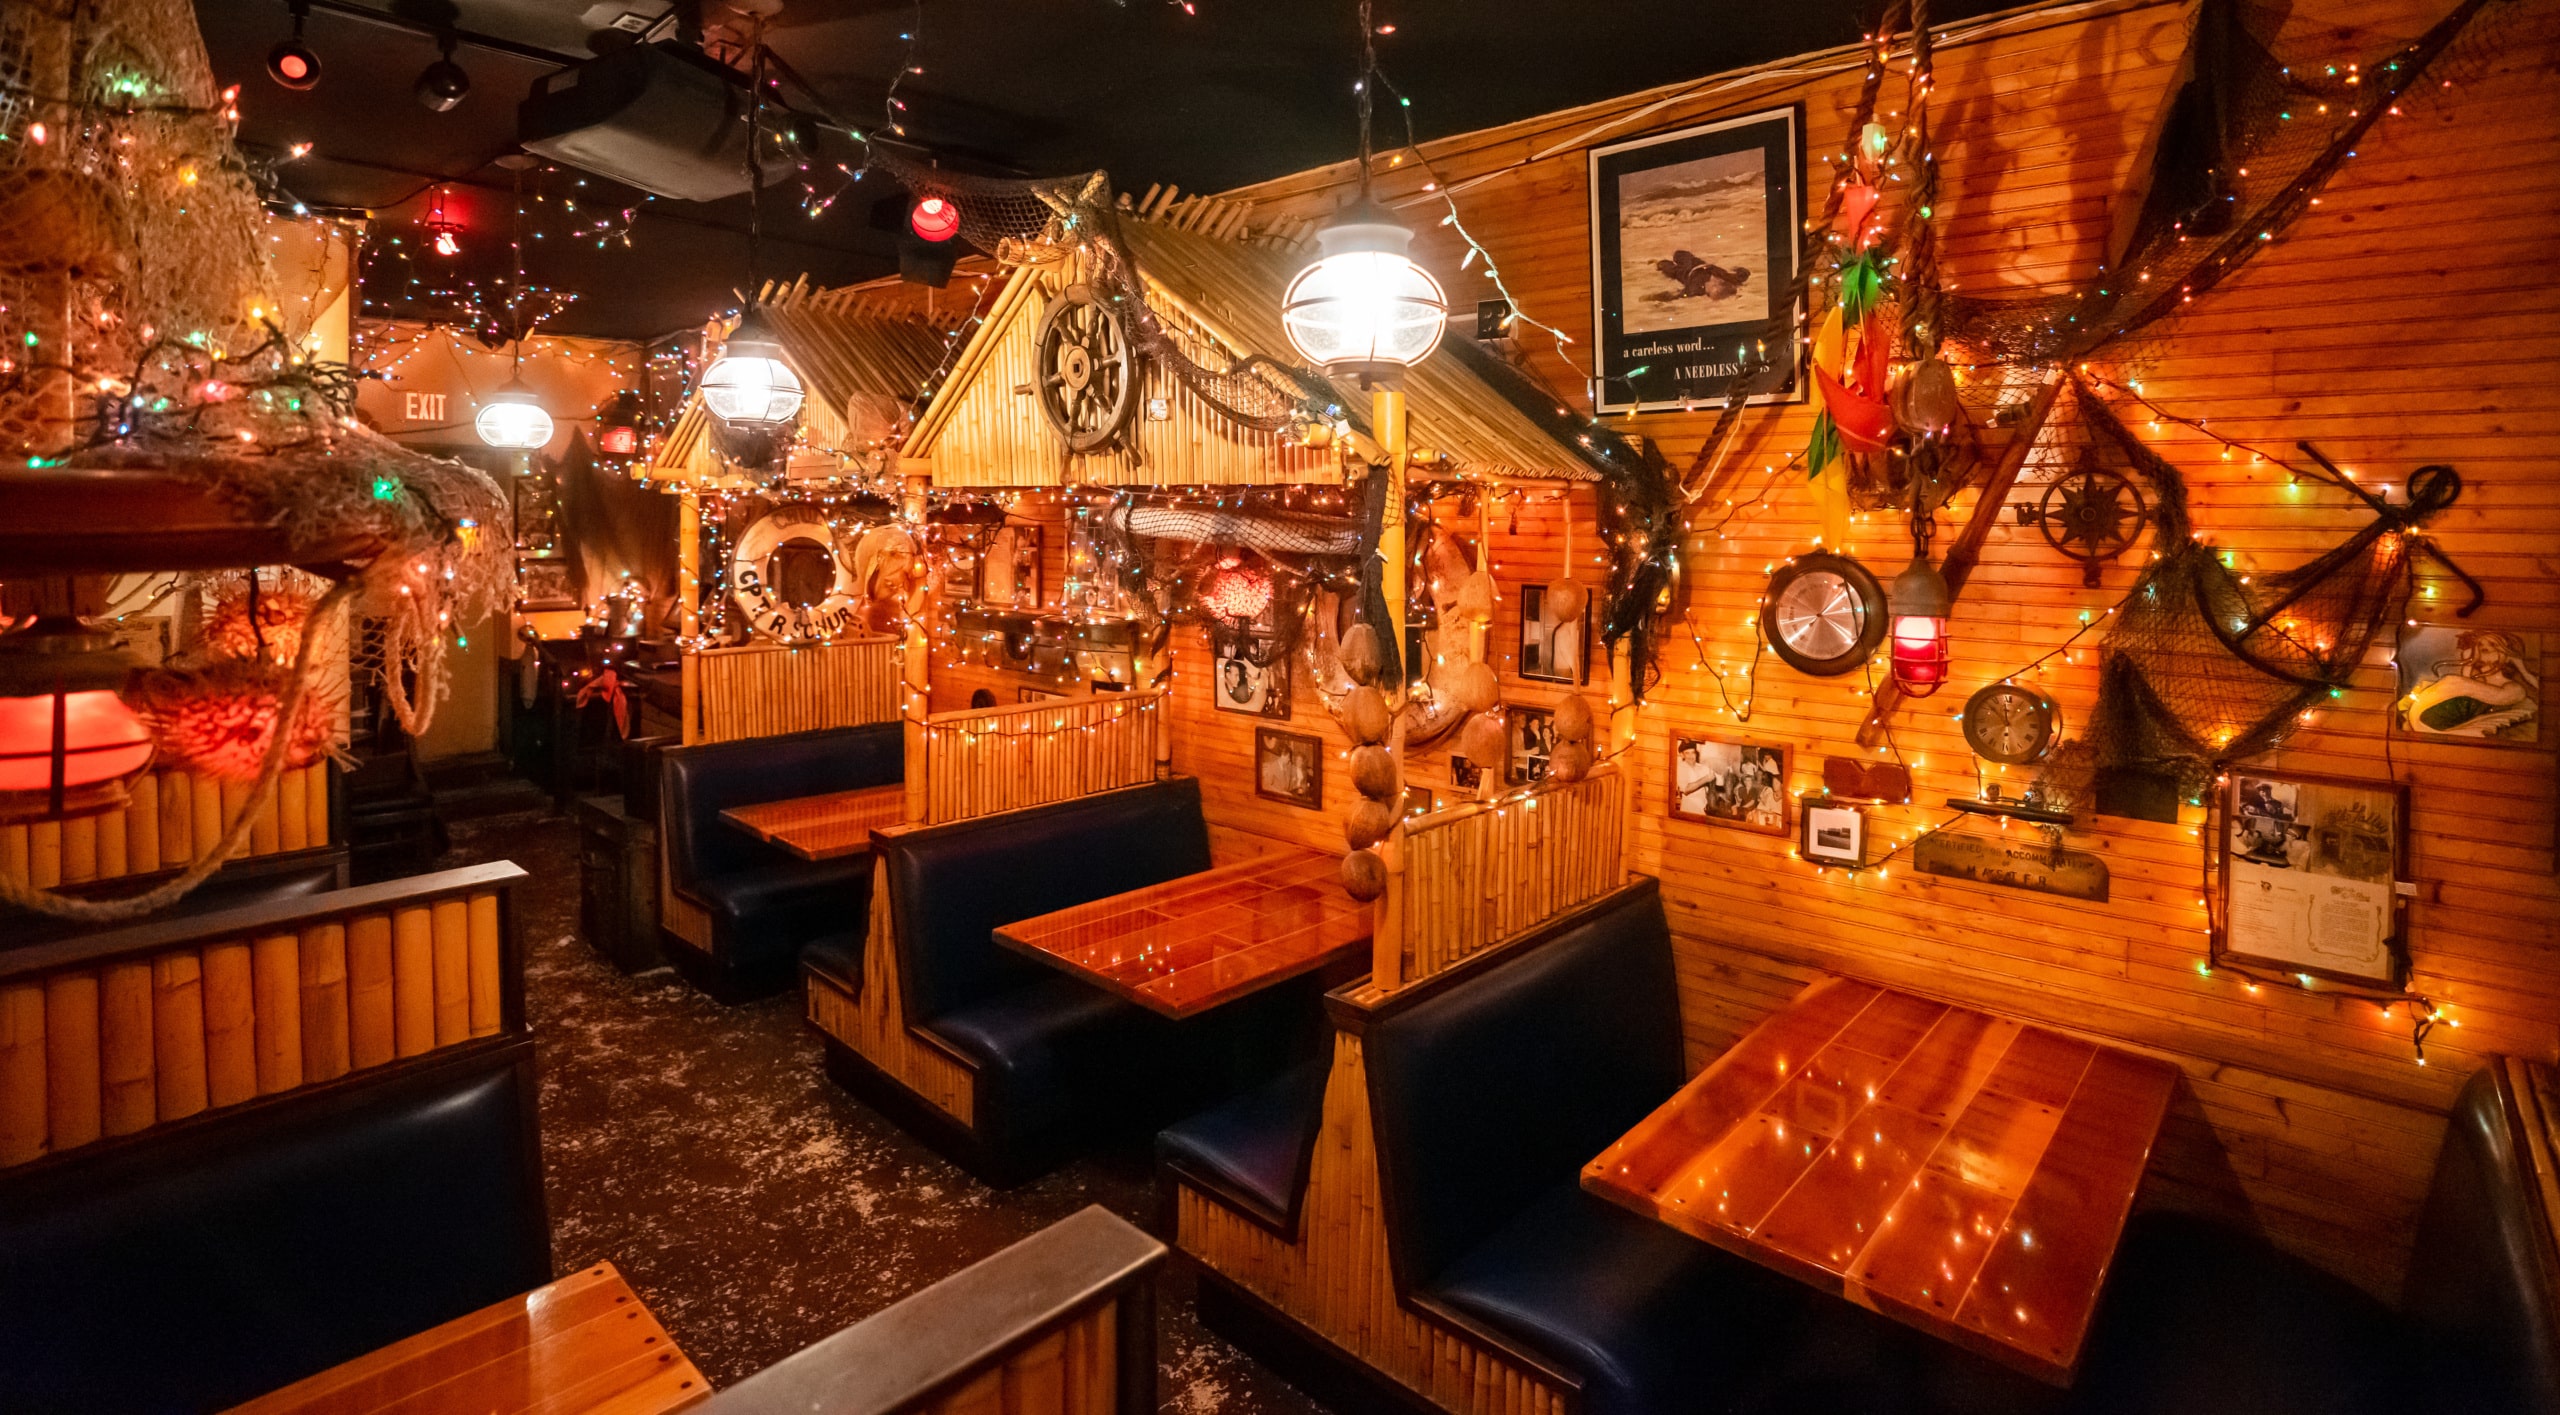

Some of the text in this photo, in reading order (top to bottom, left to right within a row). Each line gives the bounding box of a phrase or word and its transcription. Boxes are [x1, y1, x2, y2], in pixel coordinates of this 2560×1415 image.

[1623, 337, 1714, 358] a careless word...
[1674, 367, 1681, 380] A
[1684, 363, 1739, 380] NEEDLESS
[406, 392, 447, 420] EXIT
